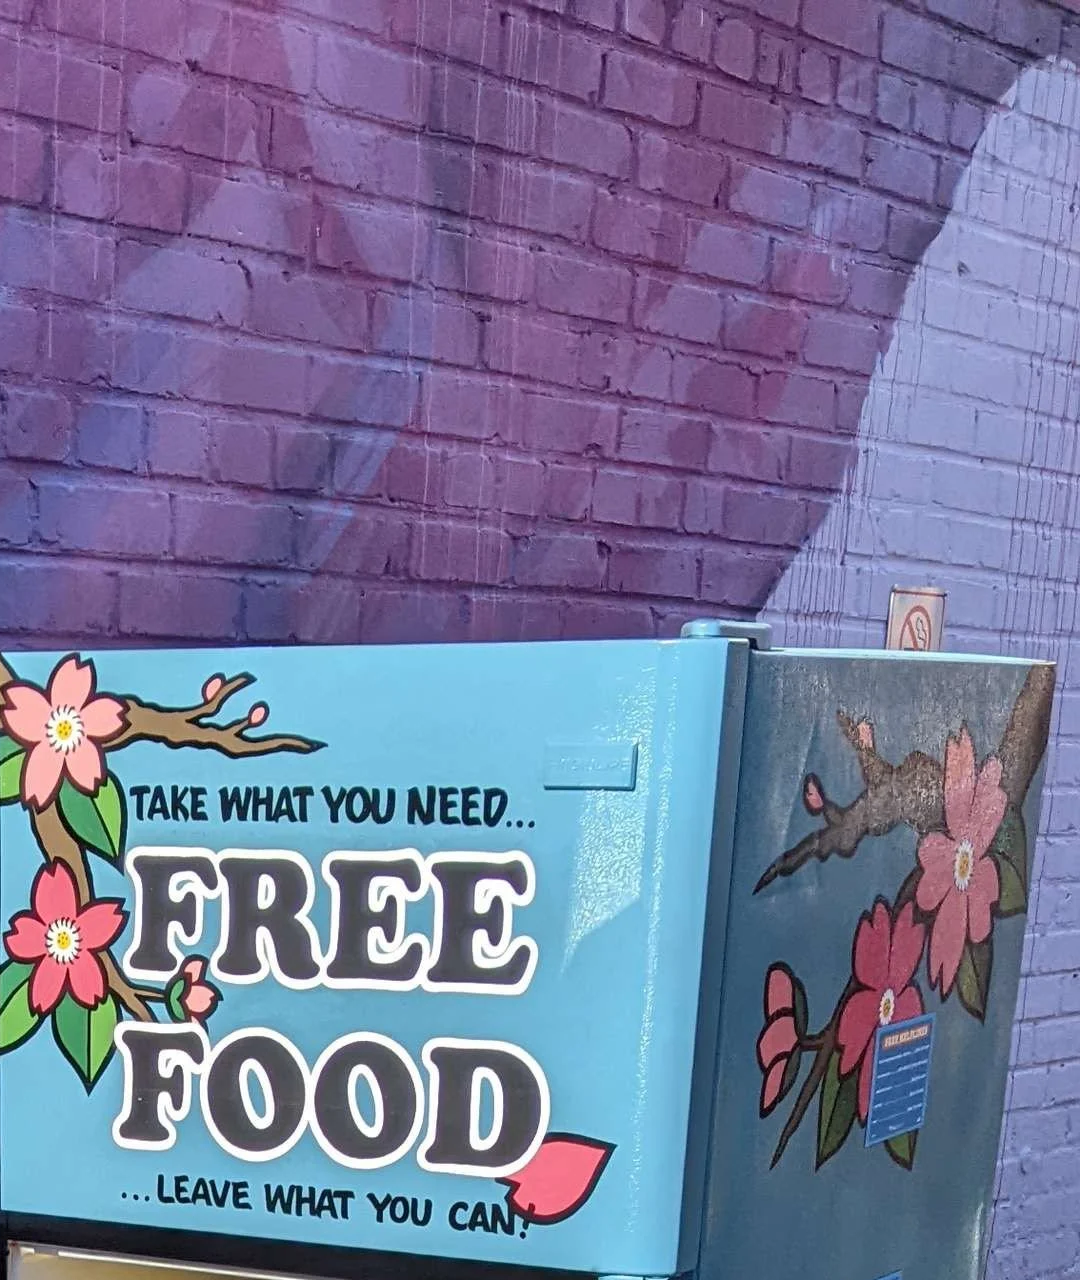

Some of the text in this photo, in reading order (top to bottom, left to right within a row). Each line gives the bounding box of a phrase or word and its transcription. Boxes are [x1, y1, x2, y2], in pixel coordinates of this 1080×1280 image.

[130, 785, 535, 828] TAKE WHAT YOU NEED...
[125, 847, 538, 994] FREE
[113, 1021, 549, 1178] FOOD
[265, 1183, 355, 1220] WHAT
[371, 1192, 433, 1227] YOU
[448, 1201, 535, 1239] CAN!
